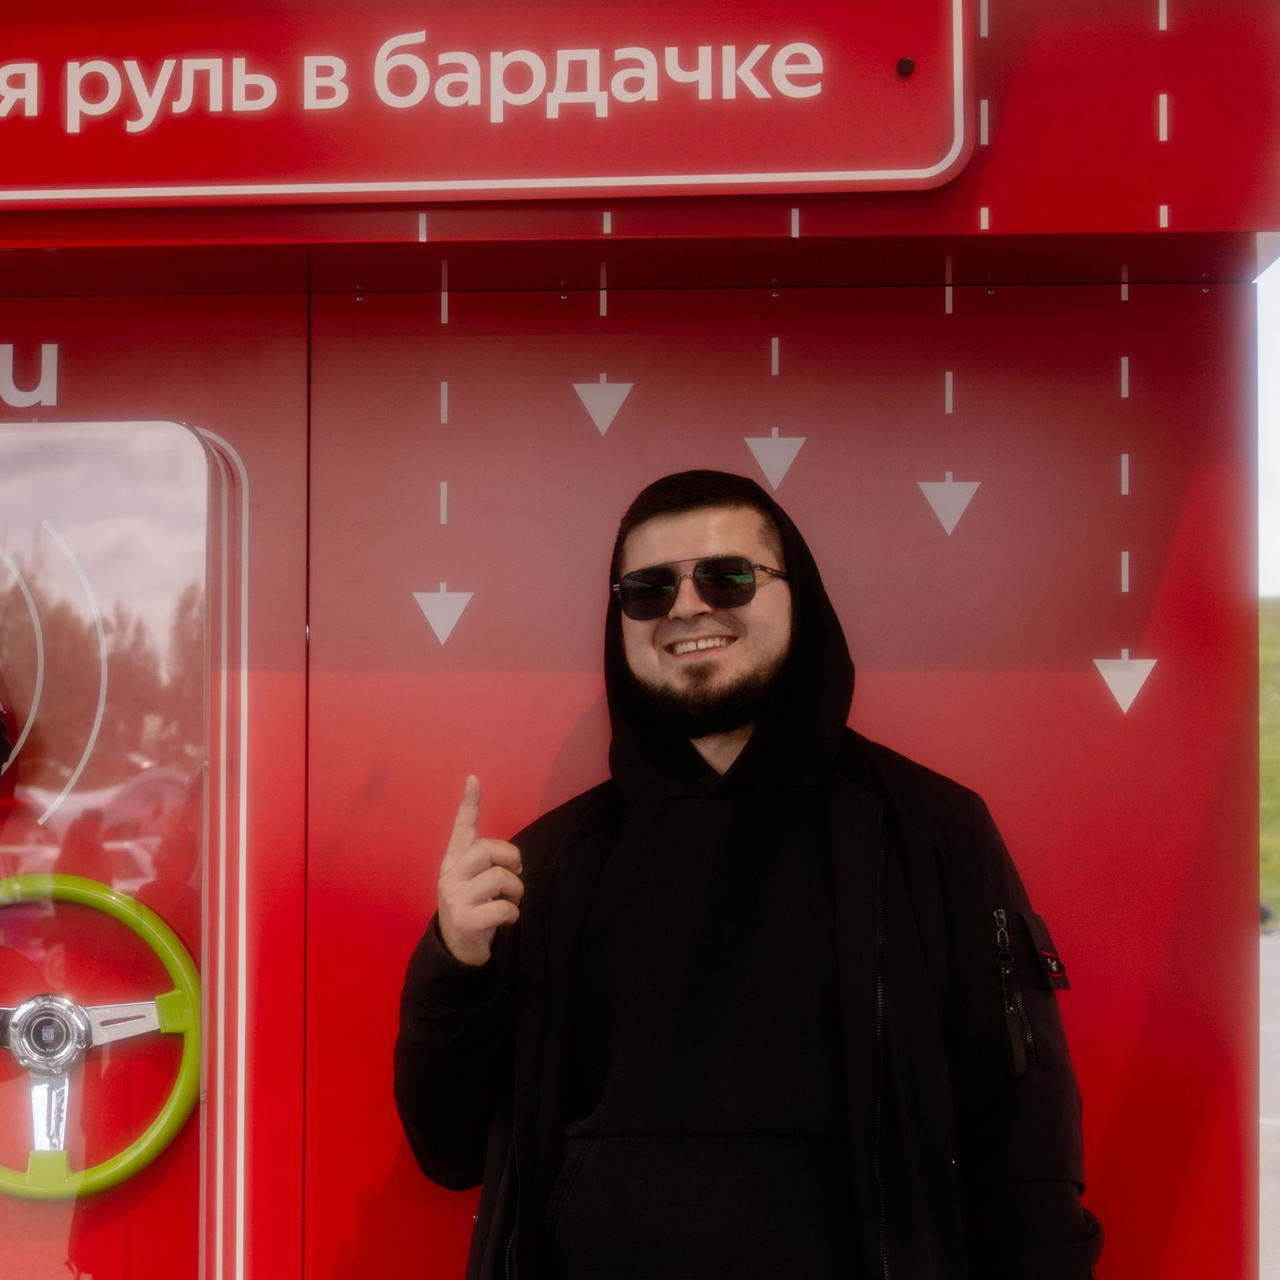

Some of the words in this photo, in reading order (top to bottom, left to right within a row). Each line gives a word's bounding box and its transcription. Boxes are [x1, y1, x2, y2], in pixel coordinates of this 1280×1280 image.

[66, 57, 278, 134] руль
[303, 55, 350, 110] в
[373, 29, 824, 124] бардачке
